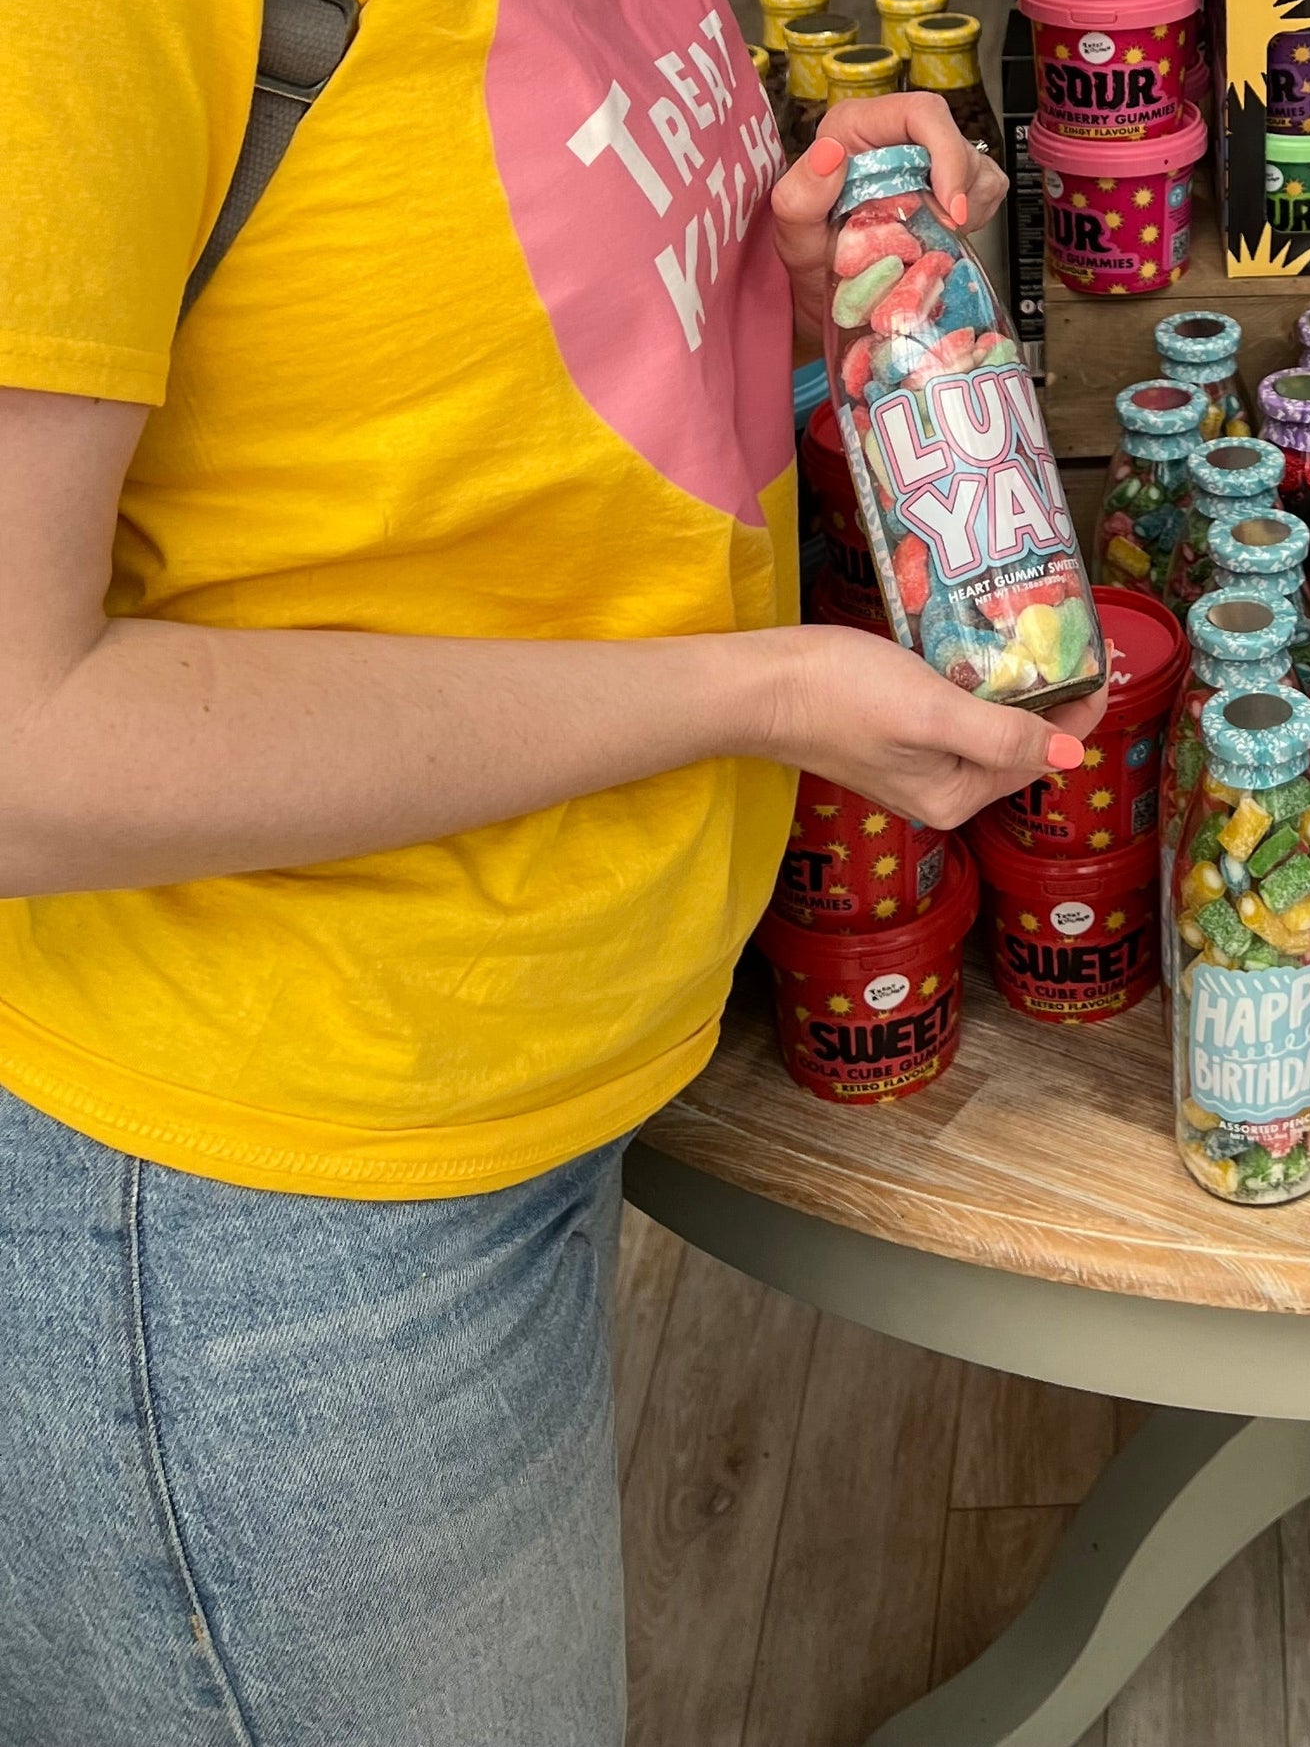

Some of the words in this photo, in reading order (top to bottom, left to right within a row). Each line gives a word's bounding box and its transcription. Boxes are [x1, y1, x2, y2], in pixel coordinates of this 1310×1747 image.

[1045, 63, 1163, 111] SOUR
[566, 9, 737, 218] TREAT
[1114, 102, 1176, 124] GUMMIES
[1063, 126, 1091, 136] ZINGY
[1094, 125, 1141, 136] FLAVOUR
[1066, 255, 1135, 269] GUMMIES
[874, 367, 1048, 495] LUV
[900, 453, 1076, 577] YA!
[948, 579, 991, 604] HEART
[994, 563, 1046, 588] GUMMY
[1047, 558, 1080, 574] SWEETS
[975, 593, 992, 606] NET
[1004, 925, 1145, 984] SWEET
[1030, 998, 1065, 1011] RETRO
[1068, 993, 1121, 1011] FLAVOUR
[1035, 984, 1078, 1000] CUBE
[809, 986, 955, 1065] SWEET
[841, 1082, 880, 1092] RETRO
[883, 1062, 934, 1089] FLAVOUR
[847, 1064, 893, 1080] CUBE
[1219, 1119, 1279, 1135] ASSORTED
